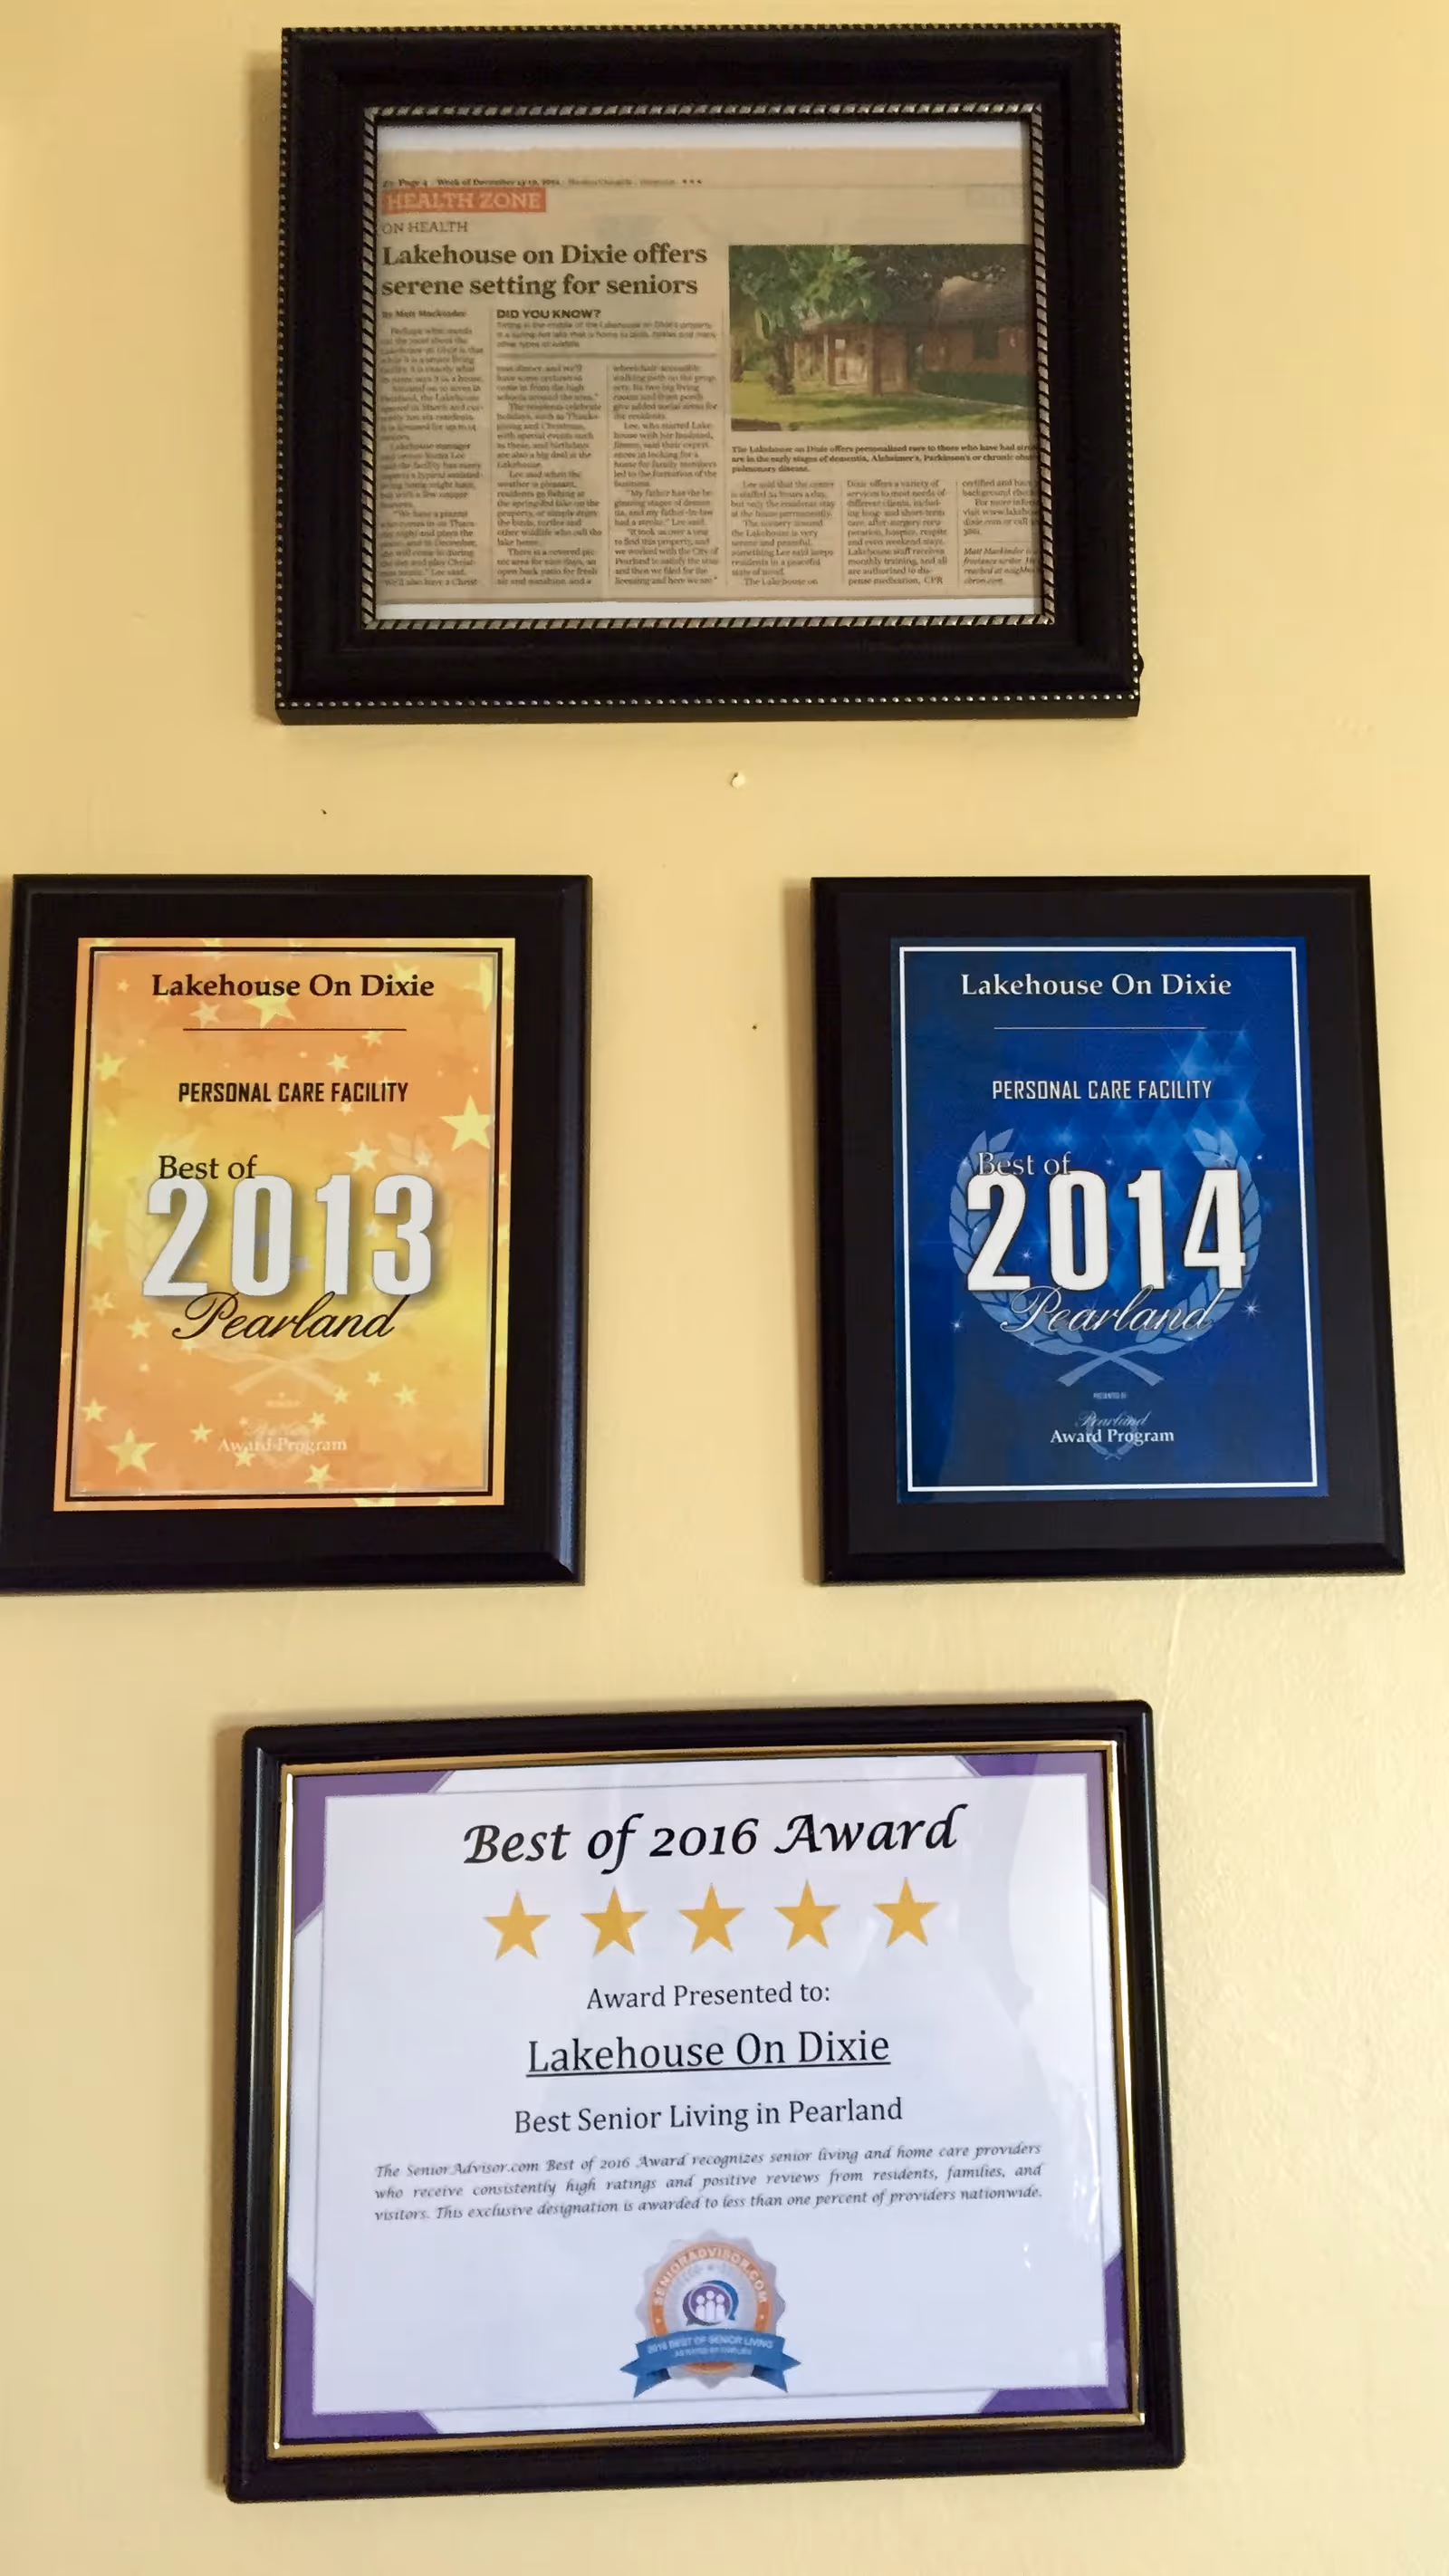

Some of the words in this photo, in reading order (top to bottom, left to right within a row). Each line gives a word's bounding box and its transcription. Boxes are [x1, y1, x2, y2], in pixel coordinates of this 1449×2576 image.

[388, 192, 474, 209] HEALTH
[479, 192, 541, 209] ZONE
[382, 223, 404, 235] ON
[408, 221, 468, 234] HEALTH
[381, 245, 516, 265] Lakehouse
[523, 249, 554, 265] on
[561, 244, 627, 264] Dixie
[633, 242, 707, 264] offers
[381, 278, 464, 295] serene
[469, 275, 556, 299] setting
[562, 274, 600, 294] for
[606, 274, 698, 294] seniors
[496, 309, 519, 319] DID
[521, 309, 550, 319] YOU
[552, 309, 601, 319] KNOW?
[749, 445, 792, 453] Lakehouse
[806, 445, 828, 453] Dixie
[771, 455, 791, 464] early
[793, 456, 818, 464] stages
[830, 455, 869, 463] dementia,
[924, 453, 971, 462] Parkinson's
[733, 465, 775, 474] pulmonary
[152, 974, 301, 997] Lakehouse
[310, 974, 351, 997] On
[361, 974, 435, 997] Dixie
[961, 973, 1103, 995] Lakehouse
[1112, 973, 1153, 995] On
[1162, 973, 1232, 995] Dixie
[178, 1081, 272, 1102] PERSONAL
[278, 1081, 324, 1102] CARE
[331, 1081, 408, 1102] FACILITY
[993, 1081, 1081, 1100] PERSONAL
[1089, 1081, 1132, 1100] CARE
[1138, 1081, 1212, 1100] FACILITY
[158, 1155, 219, 1180] Best
[227, 1154, 258, 1180] of
[977, 1152, 1034, 1177] Best
[1043, 1152, 1071, 1176] of
[143, 1174, 435, 1296] 2013
[967, 1168, 1246, 1291] 2014
[172, 1291, 411, 1339] Pearland
[1000, 1284, 1226, 1333] Pearland
[217, 1438, 272, 1452] Award
[274, 1437, 347, 1455] Program
[1051, 1429, 1102, 1444] Award
[1108, 1428, 1175, 1447] Program
[463, 1822, 571, 1864] Best
[587, 1812, 645, 1875] of
[649, 1817, 759, 1858] 2016
[774, 1803, 968, 1854] Award
[587, 1985, 666, 2010] Award
[674, 1981, 793, 2007] Presented
[800, 1982, 830, 2004] to:
[527, 2036, 724, 2073] Lakehouse
[736, 2033, 785, 2066] On
[799, 2030, 890, 2062] Dixie
[514, 2108, 571, 2134] Best
[579, 2106, 662, 2132] Senior
[670, 2104, 749, 2131] Living
[757, 2102, 781, 2125] in
[789, 2097, 904, 2124] Pearland
[376, 2165, 399, 2178] The
[545, 2158, 575, 2173] Best
[581, 2156, 598, 2173] of
[600, 2157, 630, 2169] 2016
[636, 2154, 686, 2168] Award
[692, 2152, 764, 2169] recognizes
[770, 2149, 812, 2164] senior
[818, 2148, 859, 2166] living
[865, 2147, 891, 2160] and
[897, 2145, 933, 2159] home
[938, 2147, 968, 2158] care
[974, 2140, 1041, 2161] providers
[375, 2186, 404, 2199] who
[413, 2184, 464, 2198] receive
[473, 2179, 556, 2197] consistently
[565, 2177, 596, 2197] high
[606, 2176, 657, 2195] ratings
[666, 2175, 693, 2189] and
[702, 2173, 757, 2191] positive
[766, 2171, 820, 2186] reviews
[829, 2168, 863, 2187] from
[873, 2167, 939, 2182] residents,
[946, 2165, 1006, 2183] families,
[1014, 2162, 1042, 2178] and
[375, 2206, 430, 2221] visitors.
[437, 2204, 463, 2219] This
[467, 2201, 533, 2219] exclusive
[537, 2198, 618, 2218] designation
[624, 2198, 633, 2213] is
[638, 2196, 700, 2212] awarded
[705, 2196, 718, 2210] to
[723, 2194, 746, 2209] less
[751, 2192, 782, 2208] than
[787, 2194, 811, 2207] one
[814, 2189, 867, 2209] percent
[872, 2188, 888, 2206] of
[889, 2186, 955, 2206] providers
[961, 2184, 1042, 2201] nationwide.
[652, 2245, 769, 2306] SENIORADVISOR.COM
[668, 2337, 692, 2349] BEST
[694, 2336, 705, 2346] OF
[707, 2335, 743, 2346] SENIOR
[744, 2336, 774, 2350] LIVING
